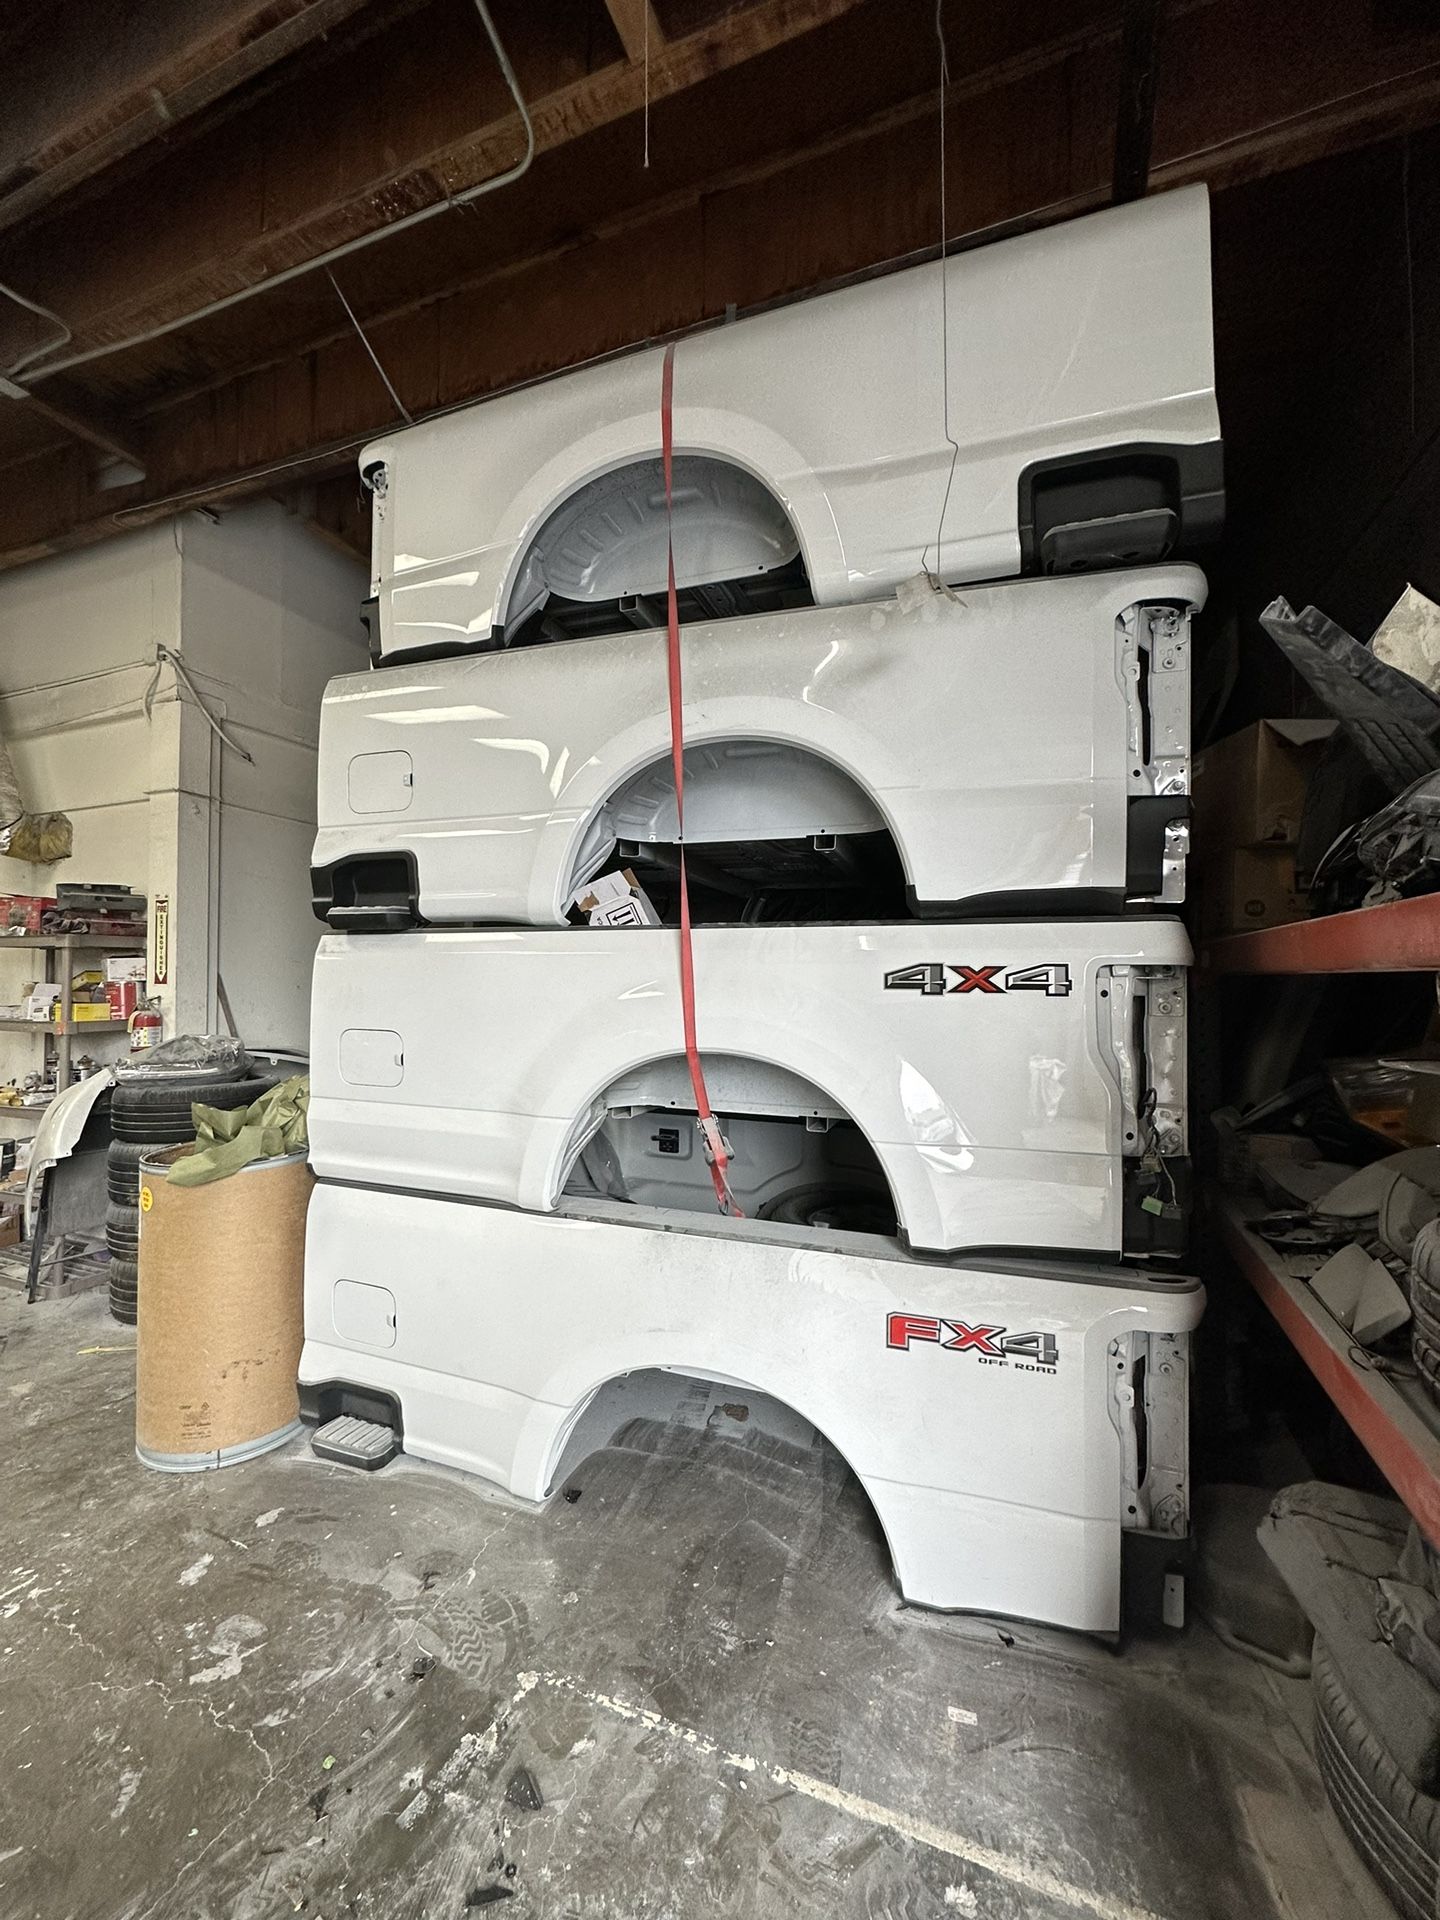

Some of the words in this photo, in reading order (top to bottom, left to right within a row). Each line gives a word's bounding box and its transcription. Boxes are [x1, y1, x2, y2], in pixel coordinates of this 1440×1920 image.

[886, 1311, 1059, 1365] FX4
[978, 1357, 1009, 1367] OFF
[1015, 1362, 1057, 1375] ROAD
